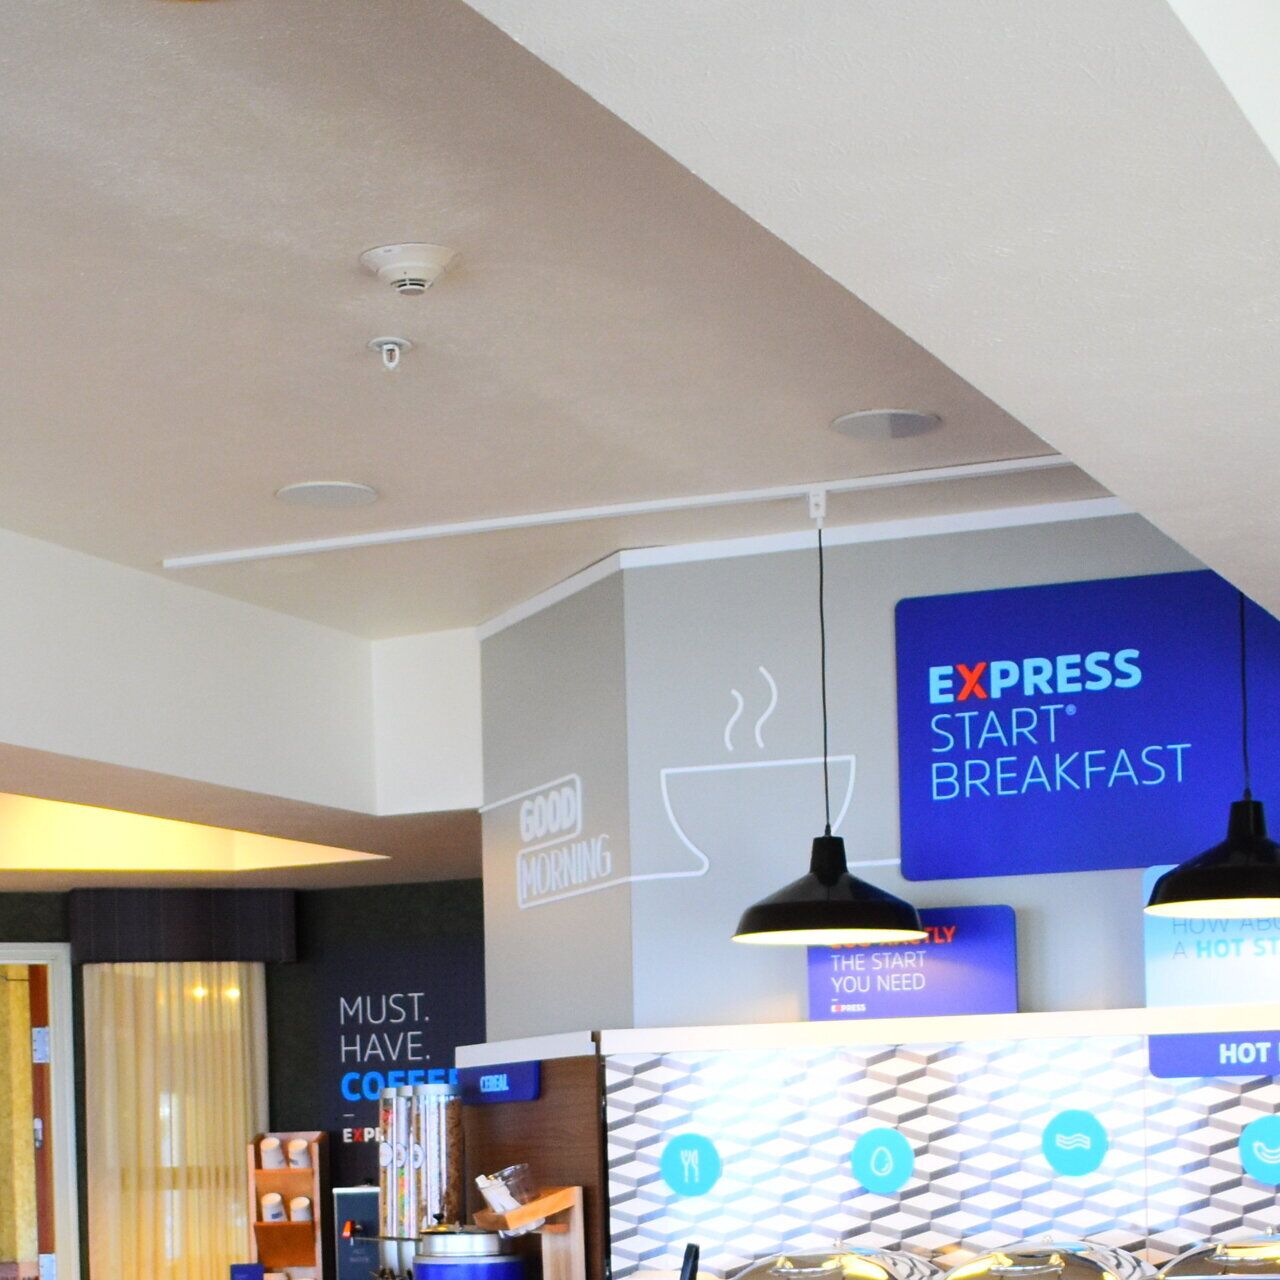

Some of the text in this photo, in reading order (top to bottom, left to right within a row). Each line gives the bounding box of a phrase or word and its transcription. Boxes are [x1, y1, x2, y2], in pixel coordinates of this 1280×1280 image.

[928, 648, 1142, 705] EXPRESS
[931, 743, 1192, 801] BREAKFAST
[520, 786, 576, 842] GOOD
[521, 833, 612, 899] MORNING
[831, 950, 927, 972] THE START
[1172, 941, 1188, 960] A
[1196, 937, 1246, 959] HOT
[831, 973, 926, 994] YOU NEED
[339, 992, 430, 1025] MUST.
[830, 1003, 867, 1013] EXPRESS
[340, 1031, 431, 1063] HAVE.
[1218, 1042, 1272, 1065] HOT
